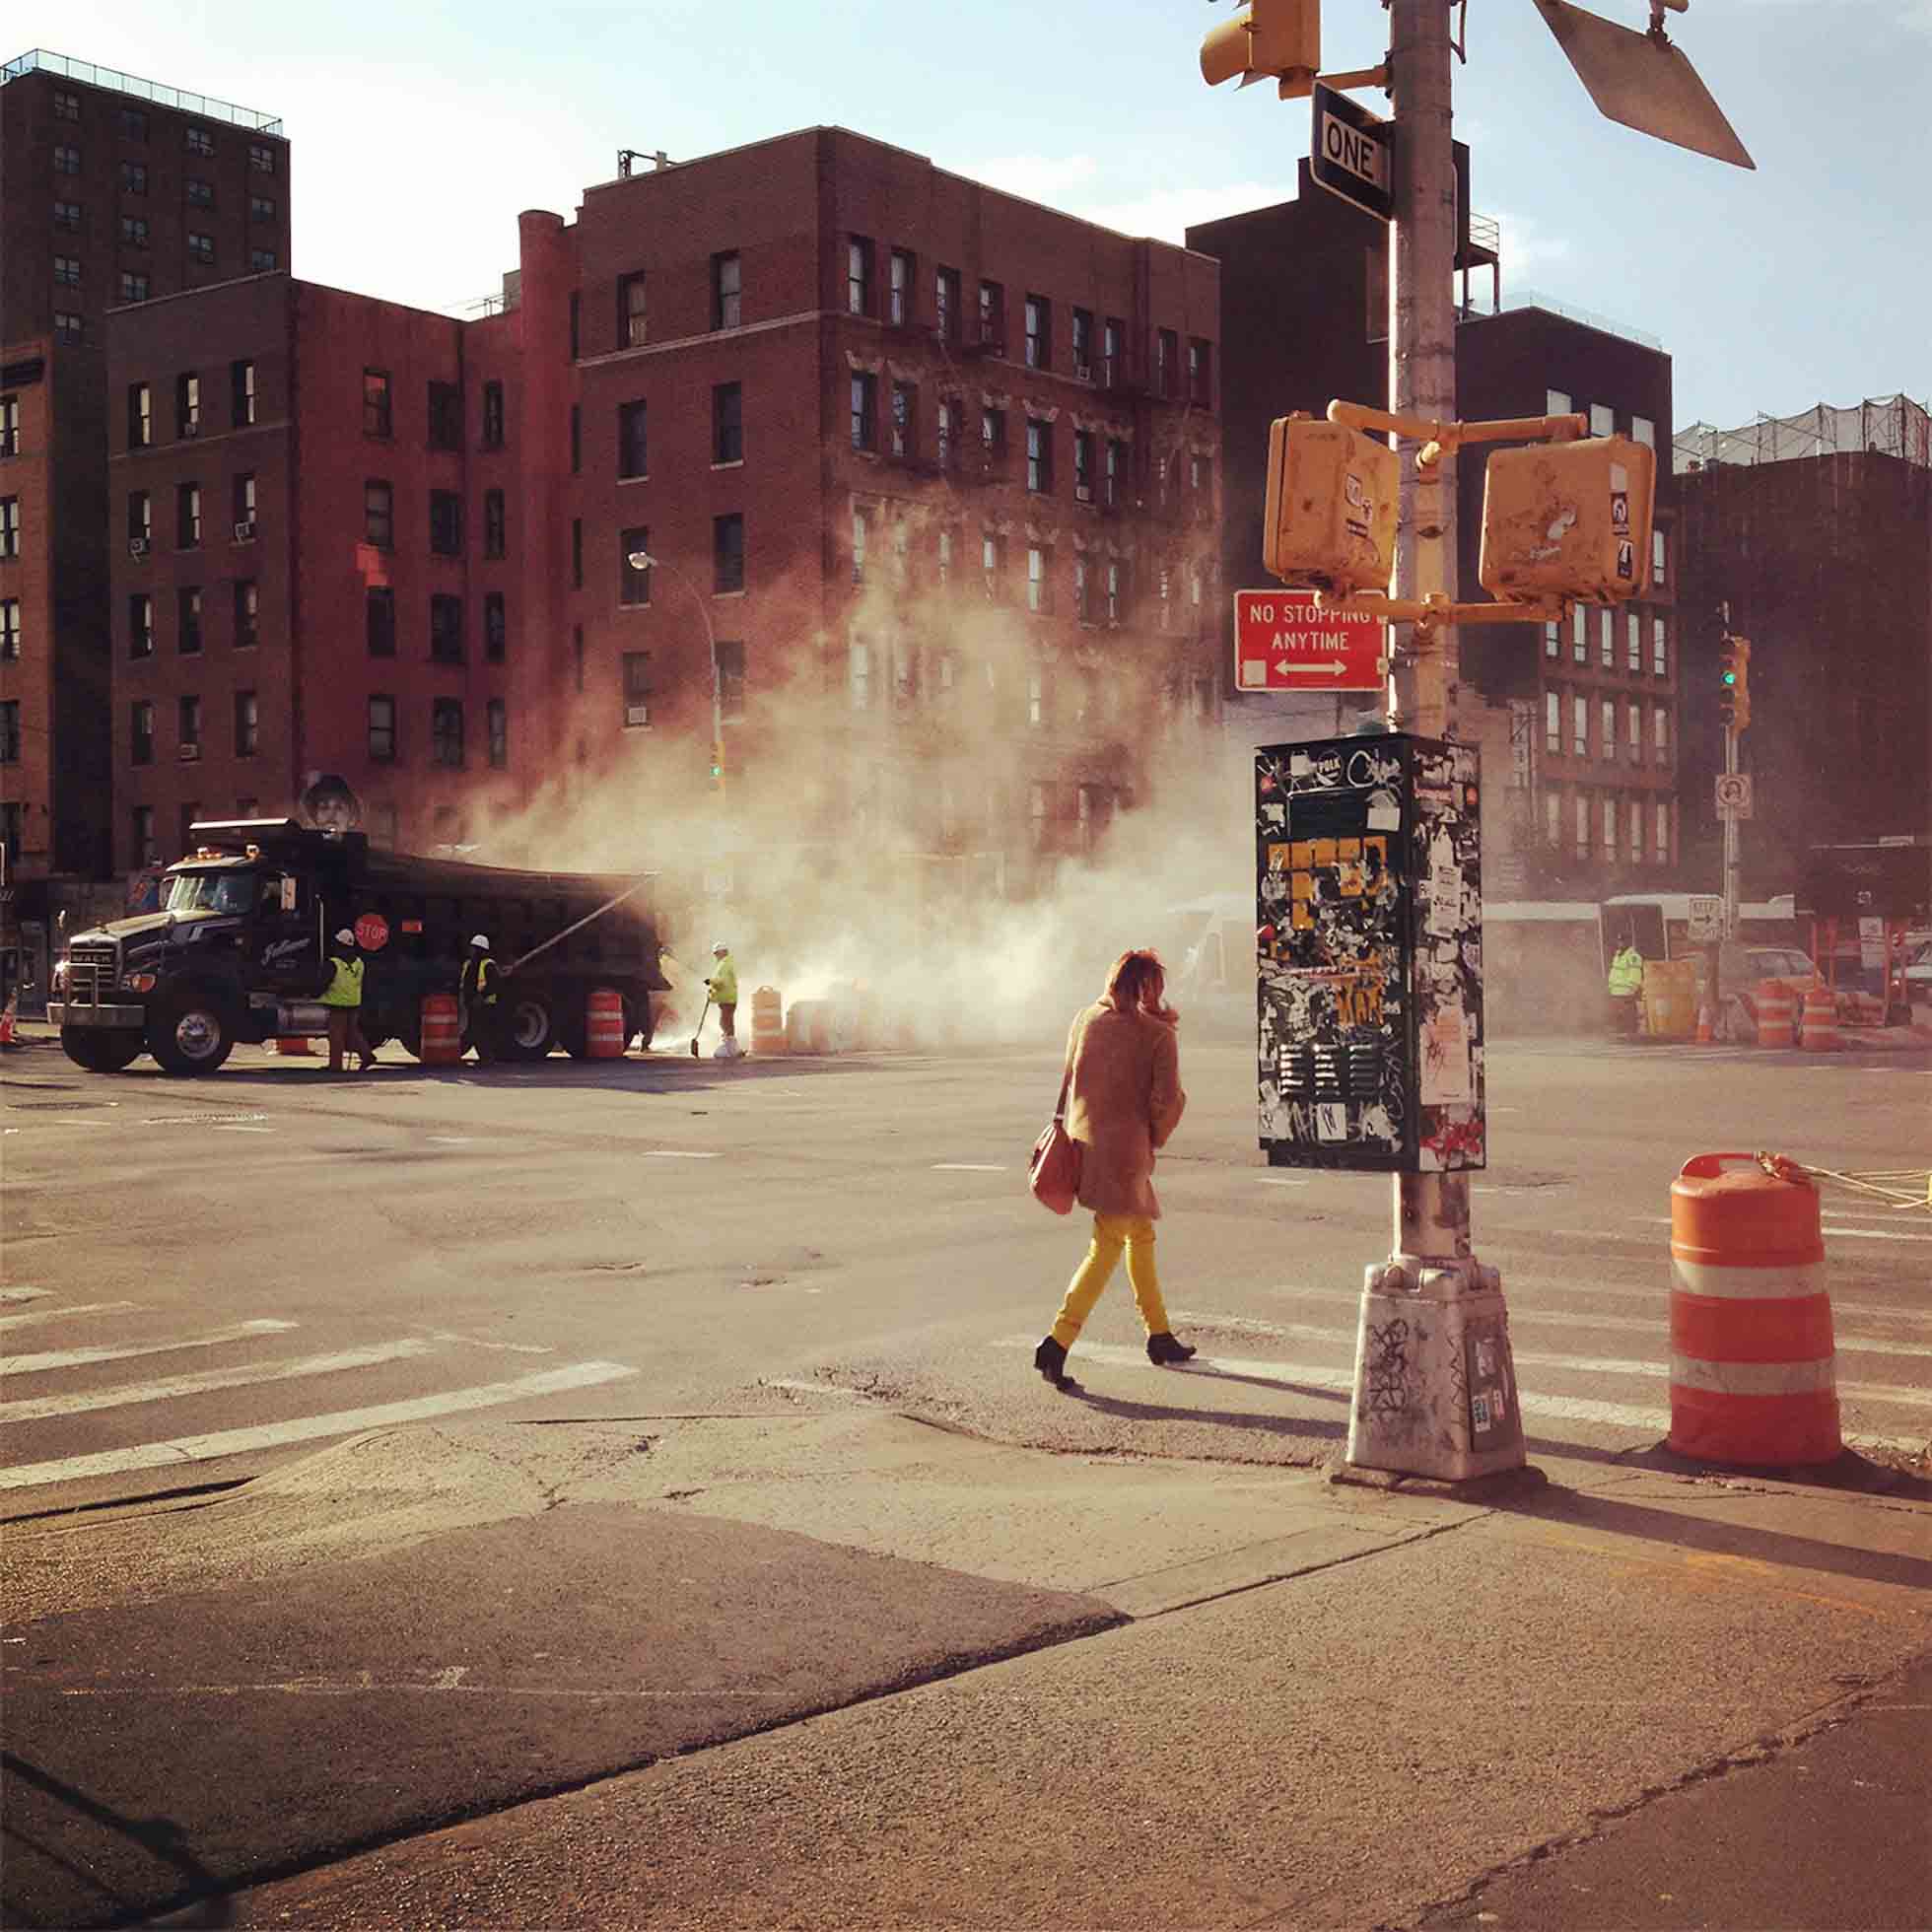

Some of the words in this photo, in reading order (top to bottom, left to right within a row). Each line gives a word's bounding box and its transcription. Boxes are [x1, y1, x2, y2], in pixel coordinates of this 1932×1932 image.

[1328, 121, 1373, 179] ONE
[1250, 604, 1275, 623] NO
[1284, 604, 1371, 623] STOPPING
[1272, 631, 1349, 651] ANYTIME
[356, 923, 388, 940] STOP
